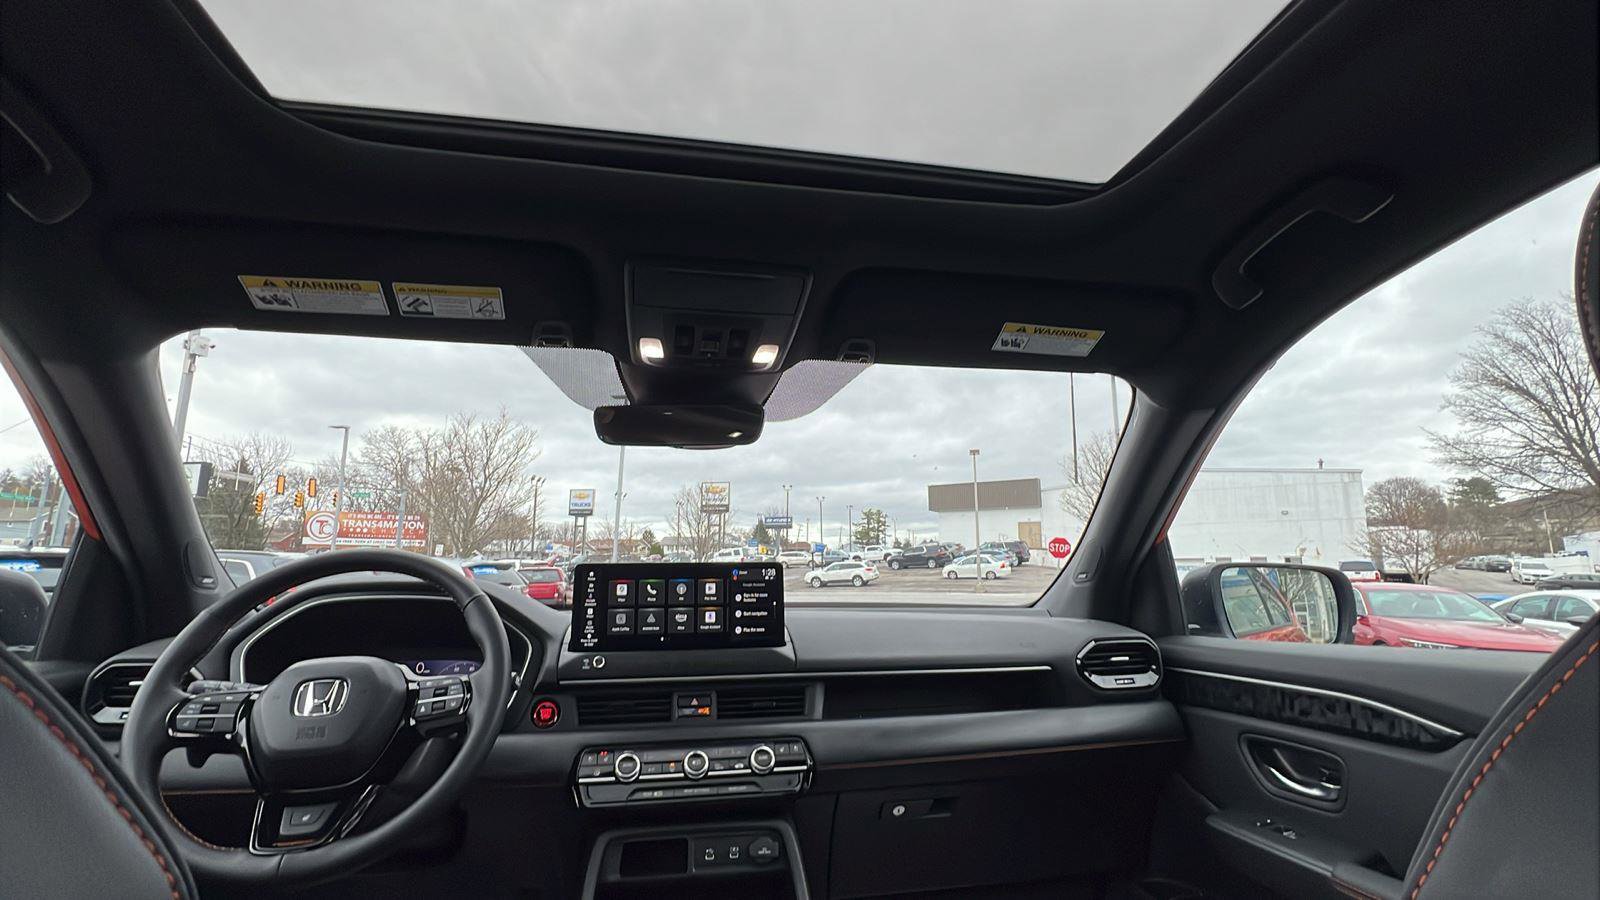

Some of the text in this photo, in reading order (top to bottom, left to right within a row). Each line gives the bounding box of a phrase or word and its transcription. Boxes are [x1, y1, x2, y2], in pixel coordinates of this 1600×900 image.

[284, 279, 363, 292] WARNING
[1033, 326, 1089, 338] WARNING
[1049, 542, 1071, 553] STOP
[762, 568, 776, 576] 1:28
